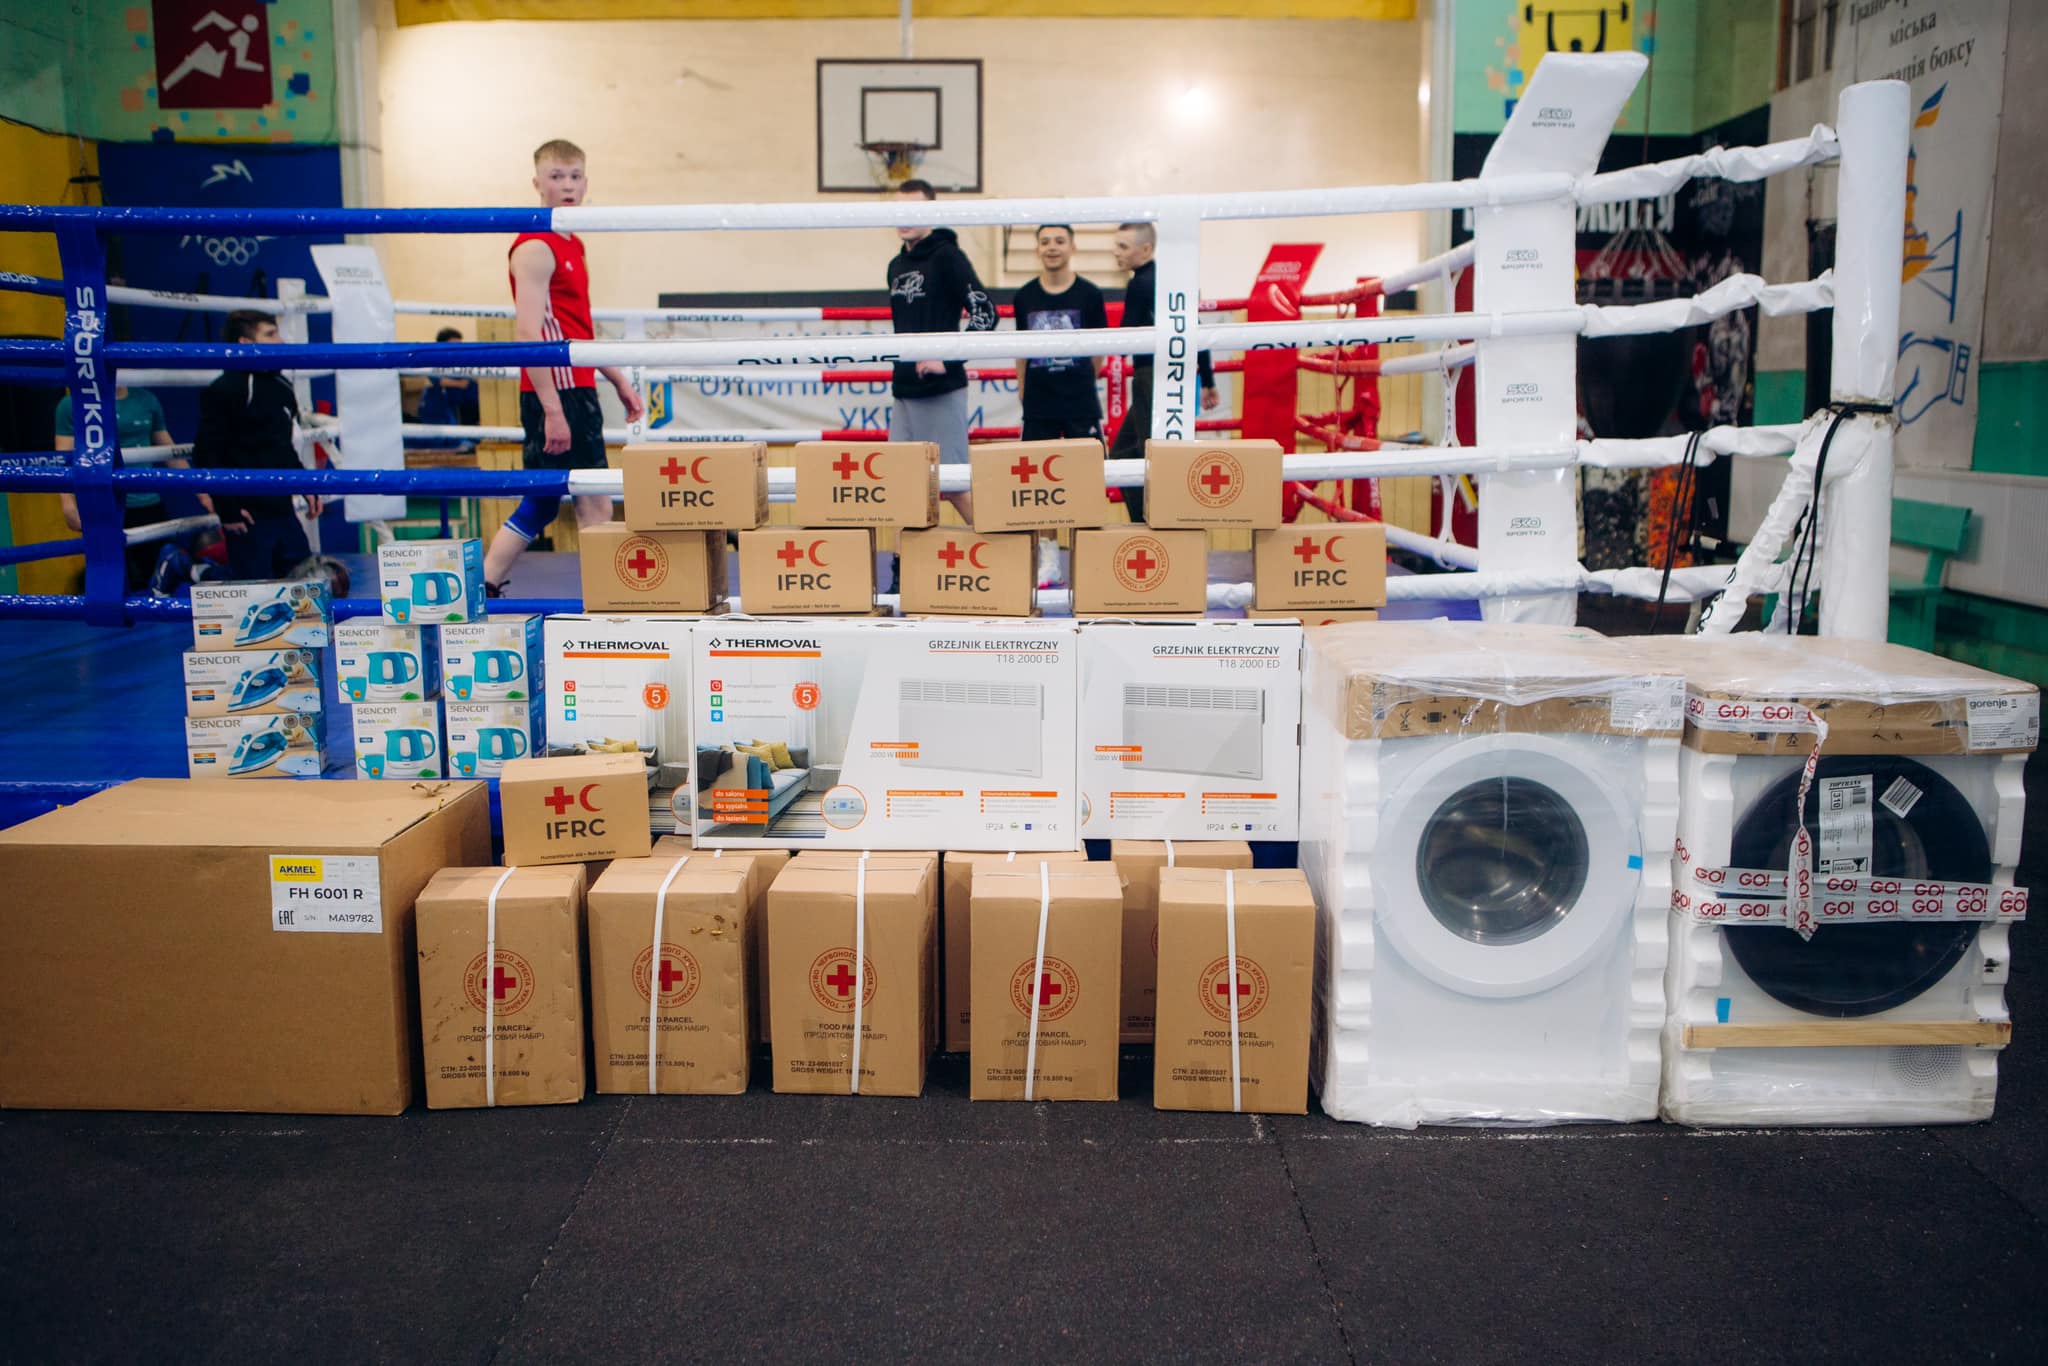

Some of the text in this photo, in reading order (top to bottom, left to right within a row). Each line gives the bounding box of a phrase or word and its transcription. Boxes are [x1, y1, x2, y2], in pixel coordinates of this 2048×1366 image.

[1889, 12, 1937, 47] міська
[1930, 36, 1976, 71] боксу
[74, 286, 105, 450] SPORTKO
[660, 490, 715, 508] IFRC
[833, 486, 887, 503] IFRC
[1012, 488, 1067, 508] IFRC
[778, 573, 831, 591] IFRC
[937, 575, 991, 592] IFRC
[1295, 570, 1348, 587] IFRC
[195, 589, 248, 599] SENCOR
[338, 628, 380, 638] SENCOR
[445, 627, 485, 636] SENCOR
[578, 641, 670, 650] THERMOVAL
[725, 638, 821, 649] THERMOVAL
[928, 640, 1059, 651] GRZEJNIK ELEKTRYCZNY
[1152, 645, 1280, 655] GRZEJNIK ELEKTRYCZNY
[189, 655, 241, 665] SENCOR
[996, 654, 1060, 664] T18 2000 ED
[1219, 659, 1280, 669] T18 2000 ED
[651, 689, 662, 705] 5
[802, 689, 813, 704] 5
[357, 706, 398, 715] SENCOR
[449, 705, 489, 713] SENCOR
[1689, 698, 1793, 721] GO! GO! GO!
[1970, 698, 2008, 710] gorenje
[190, 719, 241, 729] SENCOR
[1833, 791, 1842, 809] 310
[546, 818, 605, 840] IFRC
[1206, 823, 1224, 831] IP24
[1798, 828, 1808, 857] GO!
[1676, 838, 1691, 864] GO!
[279, 865, 316, 874] AKMEL
[1696, 867, 1770, 887] GO! GO!
[1799, 869, 1809, 899] GO!
[289, 887, 364, 900] FH 6001 R
[1827, 878, 1857, 892] GO!
[1871, 881, 1901, 894] GO!
[1914, 884, 1944, 897] GO!
[1701, 902, 1769, 917] GO! GO!
[1824, 901, 1854, 916] GO!
[1868, 899, 1898, 914] GO!
[1912, 899, 1942, 914] GO!
[1956, 899, 1988, 914] GO!
[278, 910, 295, 925] EAC
[328, 914, 375, 923] MA19782
[641, 1016, 694, 1024] FOD PARCEL
[496, 1024, 528, 1032] PARCEL
[819, 1023, 872, 1032] FOOD PAREL
[1040, 1031, 1071, 1039] PARCEL
[1203, 1031, 1226, 1039] FOOD
